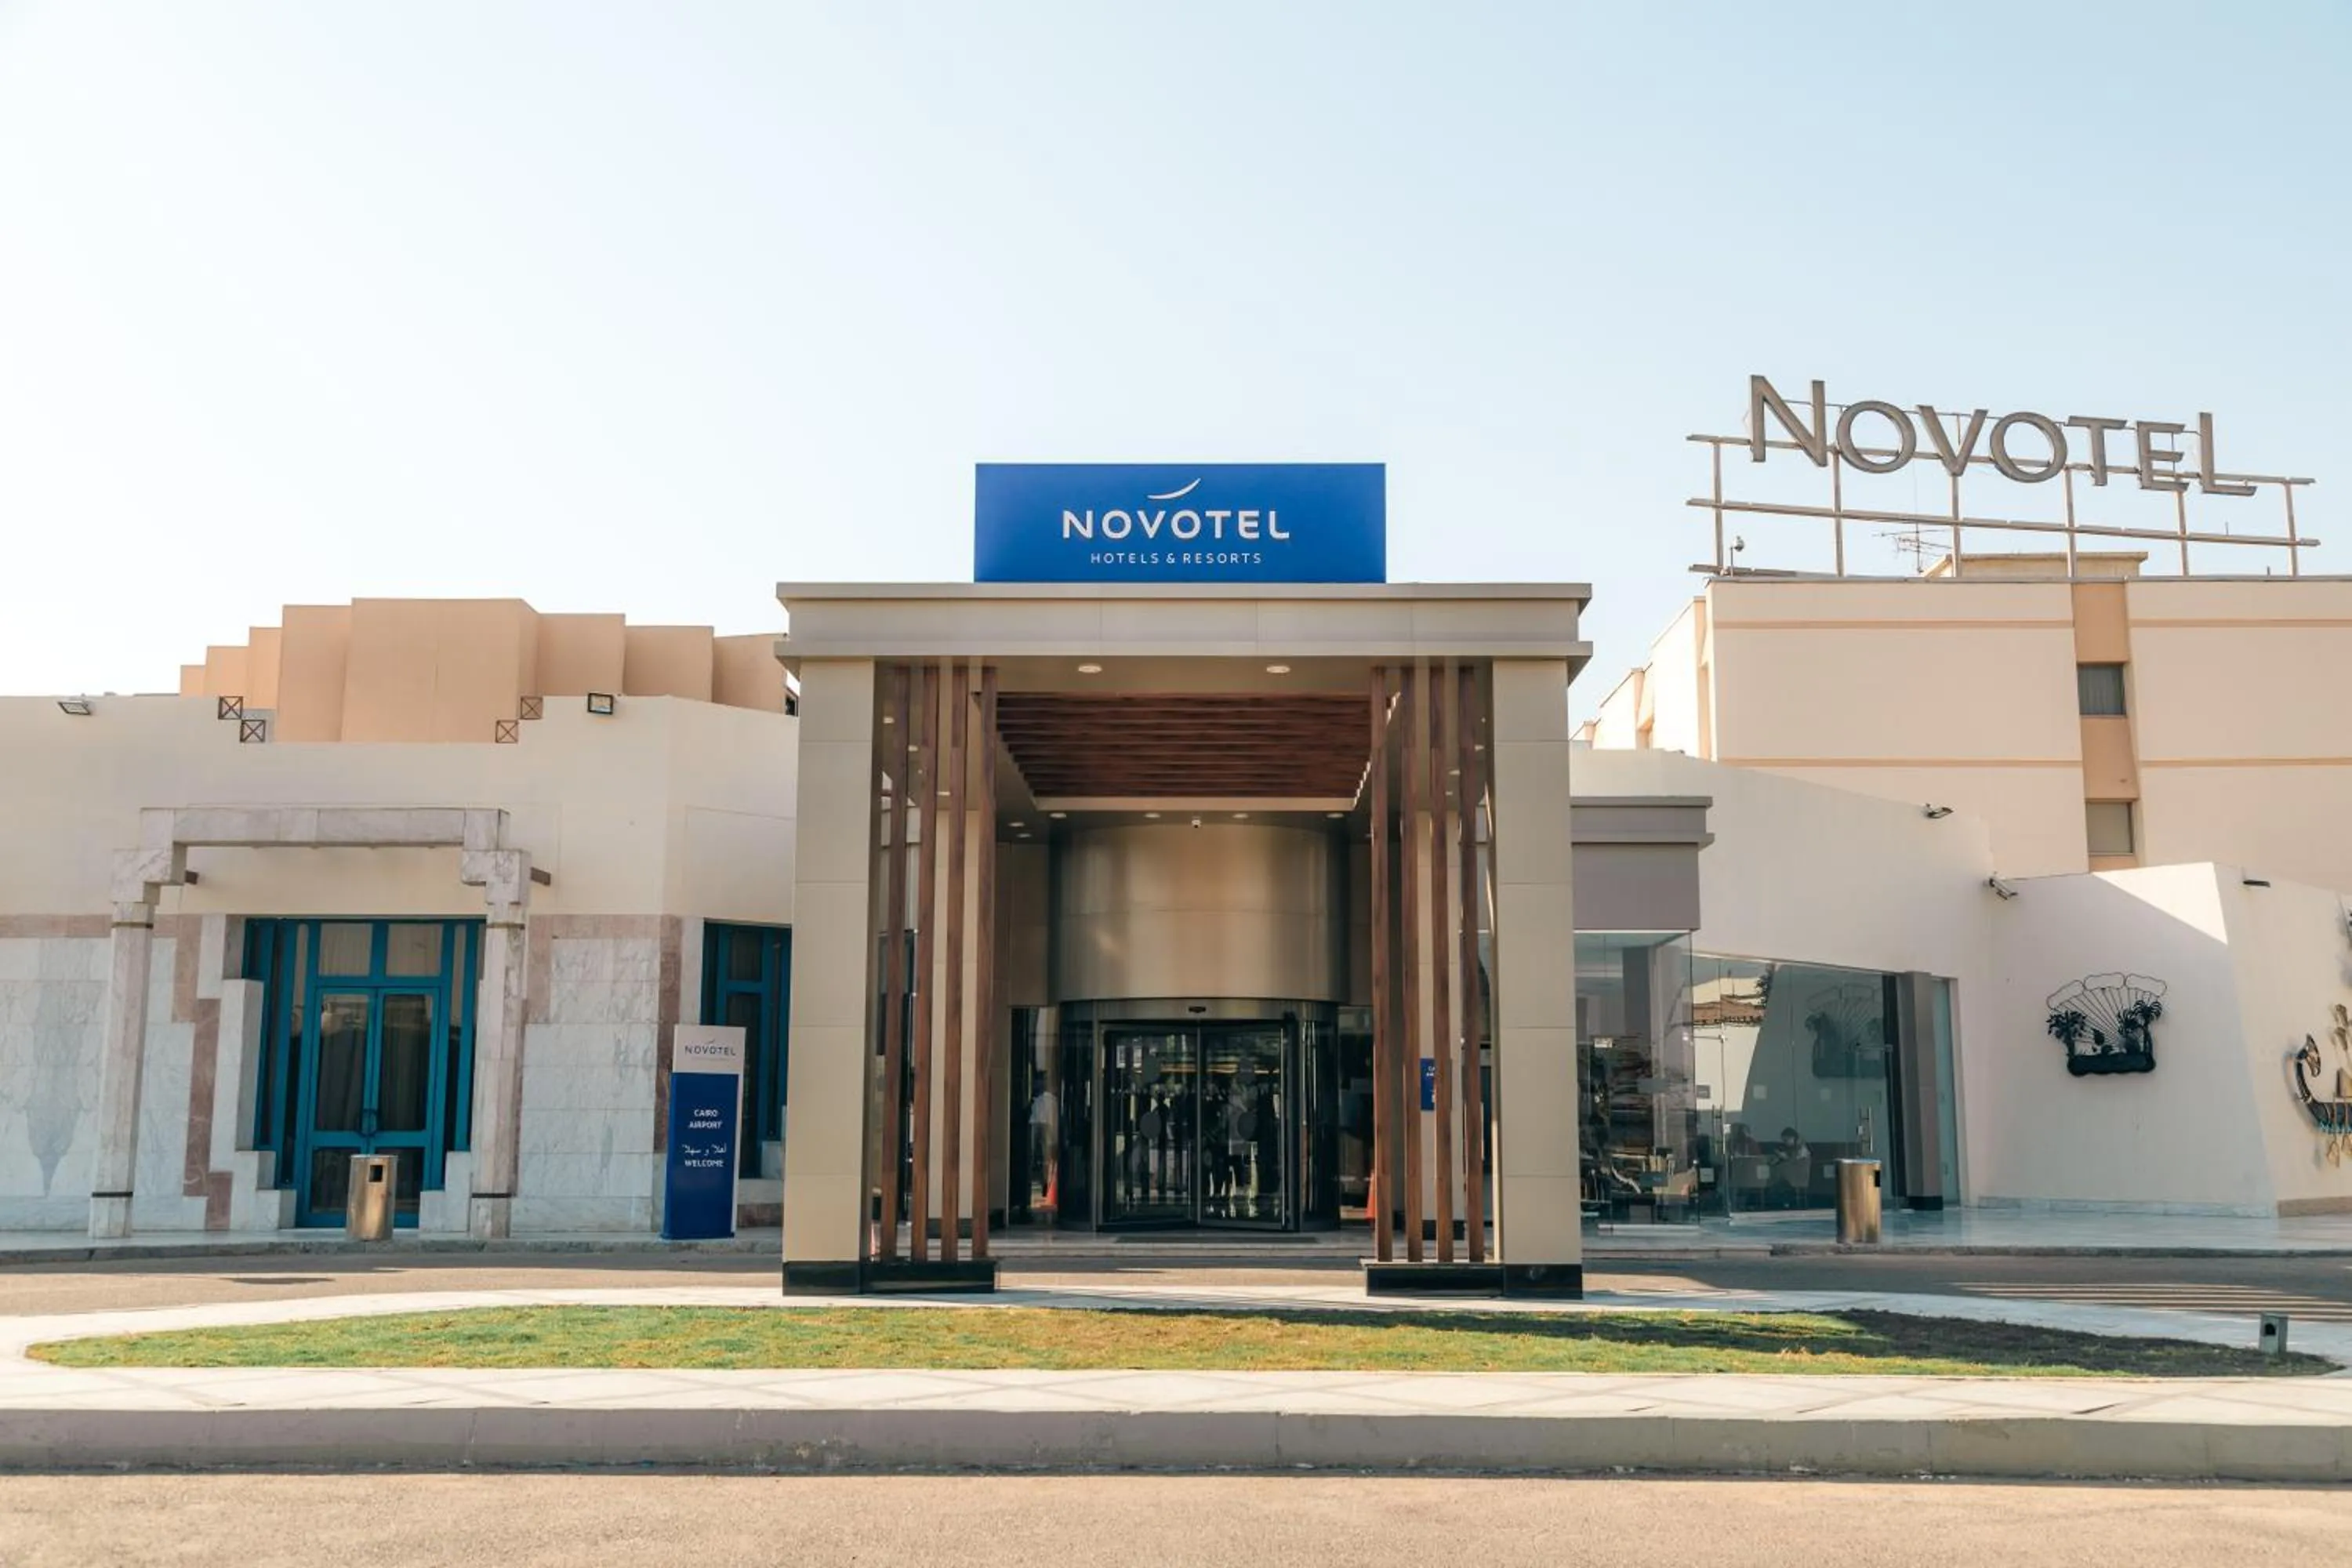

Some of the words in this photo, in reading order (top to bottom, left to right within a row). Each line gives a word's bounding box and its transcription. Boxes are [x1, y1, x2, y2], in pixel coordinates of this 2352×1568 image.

[1749, 374, 2258, 496] NOVOTEL
[1062, 510, 1290, 539] NOVOTEL
[1091, 553, 1160, 564] HOTELS
[1166, 553, 1175, 564] &
[1183, 553, 1261, 564] RESORTS
[684, 1045, 736, 1056] NOVOTEL
[694, 1109, 719, 1117] CAIRO
